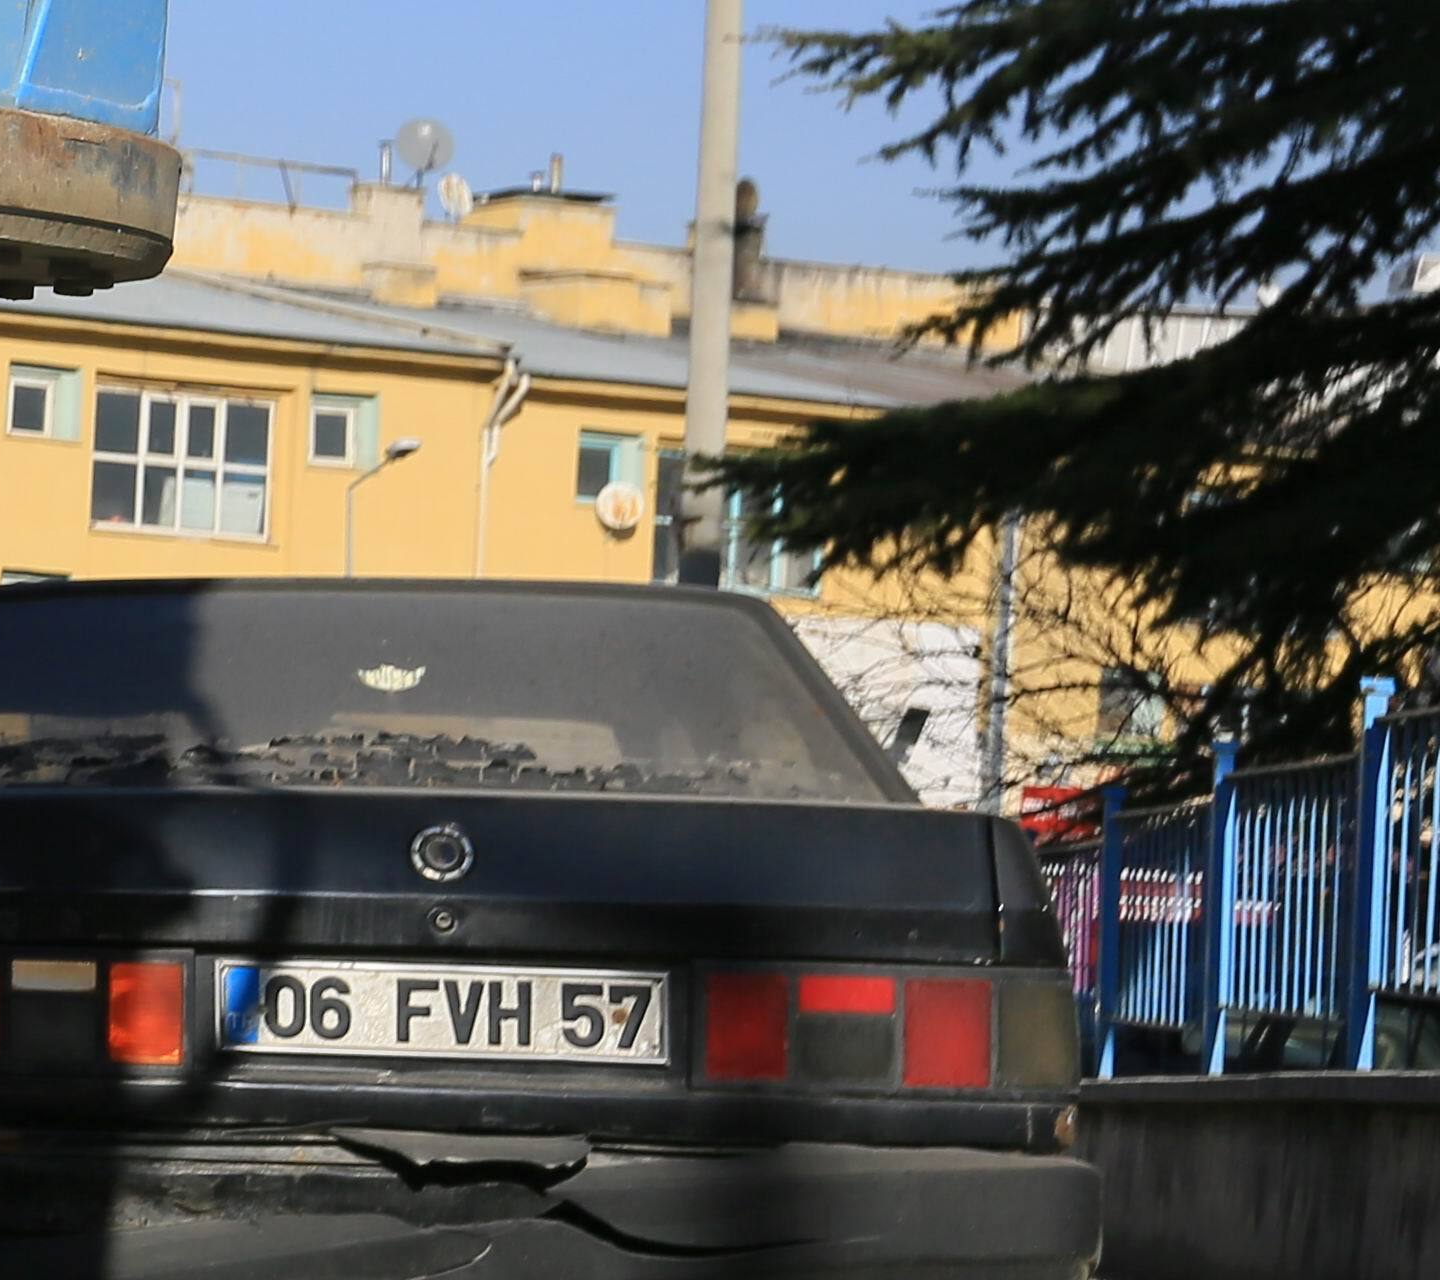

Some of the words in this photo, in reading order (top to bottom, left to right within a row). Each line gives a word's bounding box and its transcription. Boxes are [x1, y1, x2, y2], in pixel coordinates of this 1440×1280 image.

[263, 974, 352, 1040] 06
[396, 978, 532, 1047] FVH
[560, 983, 653, 1050] 57
